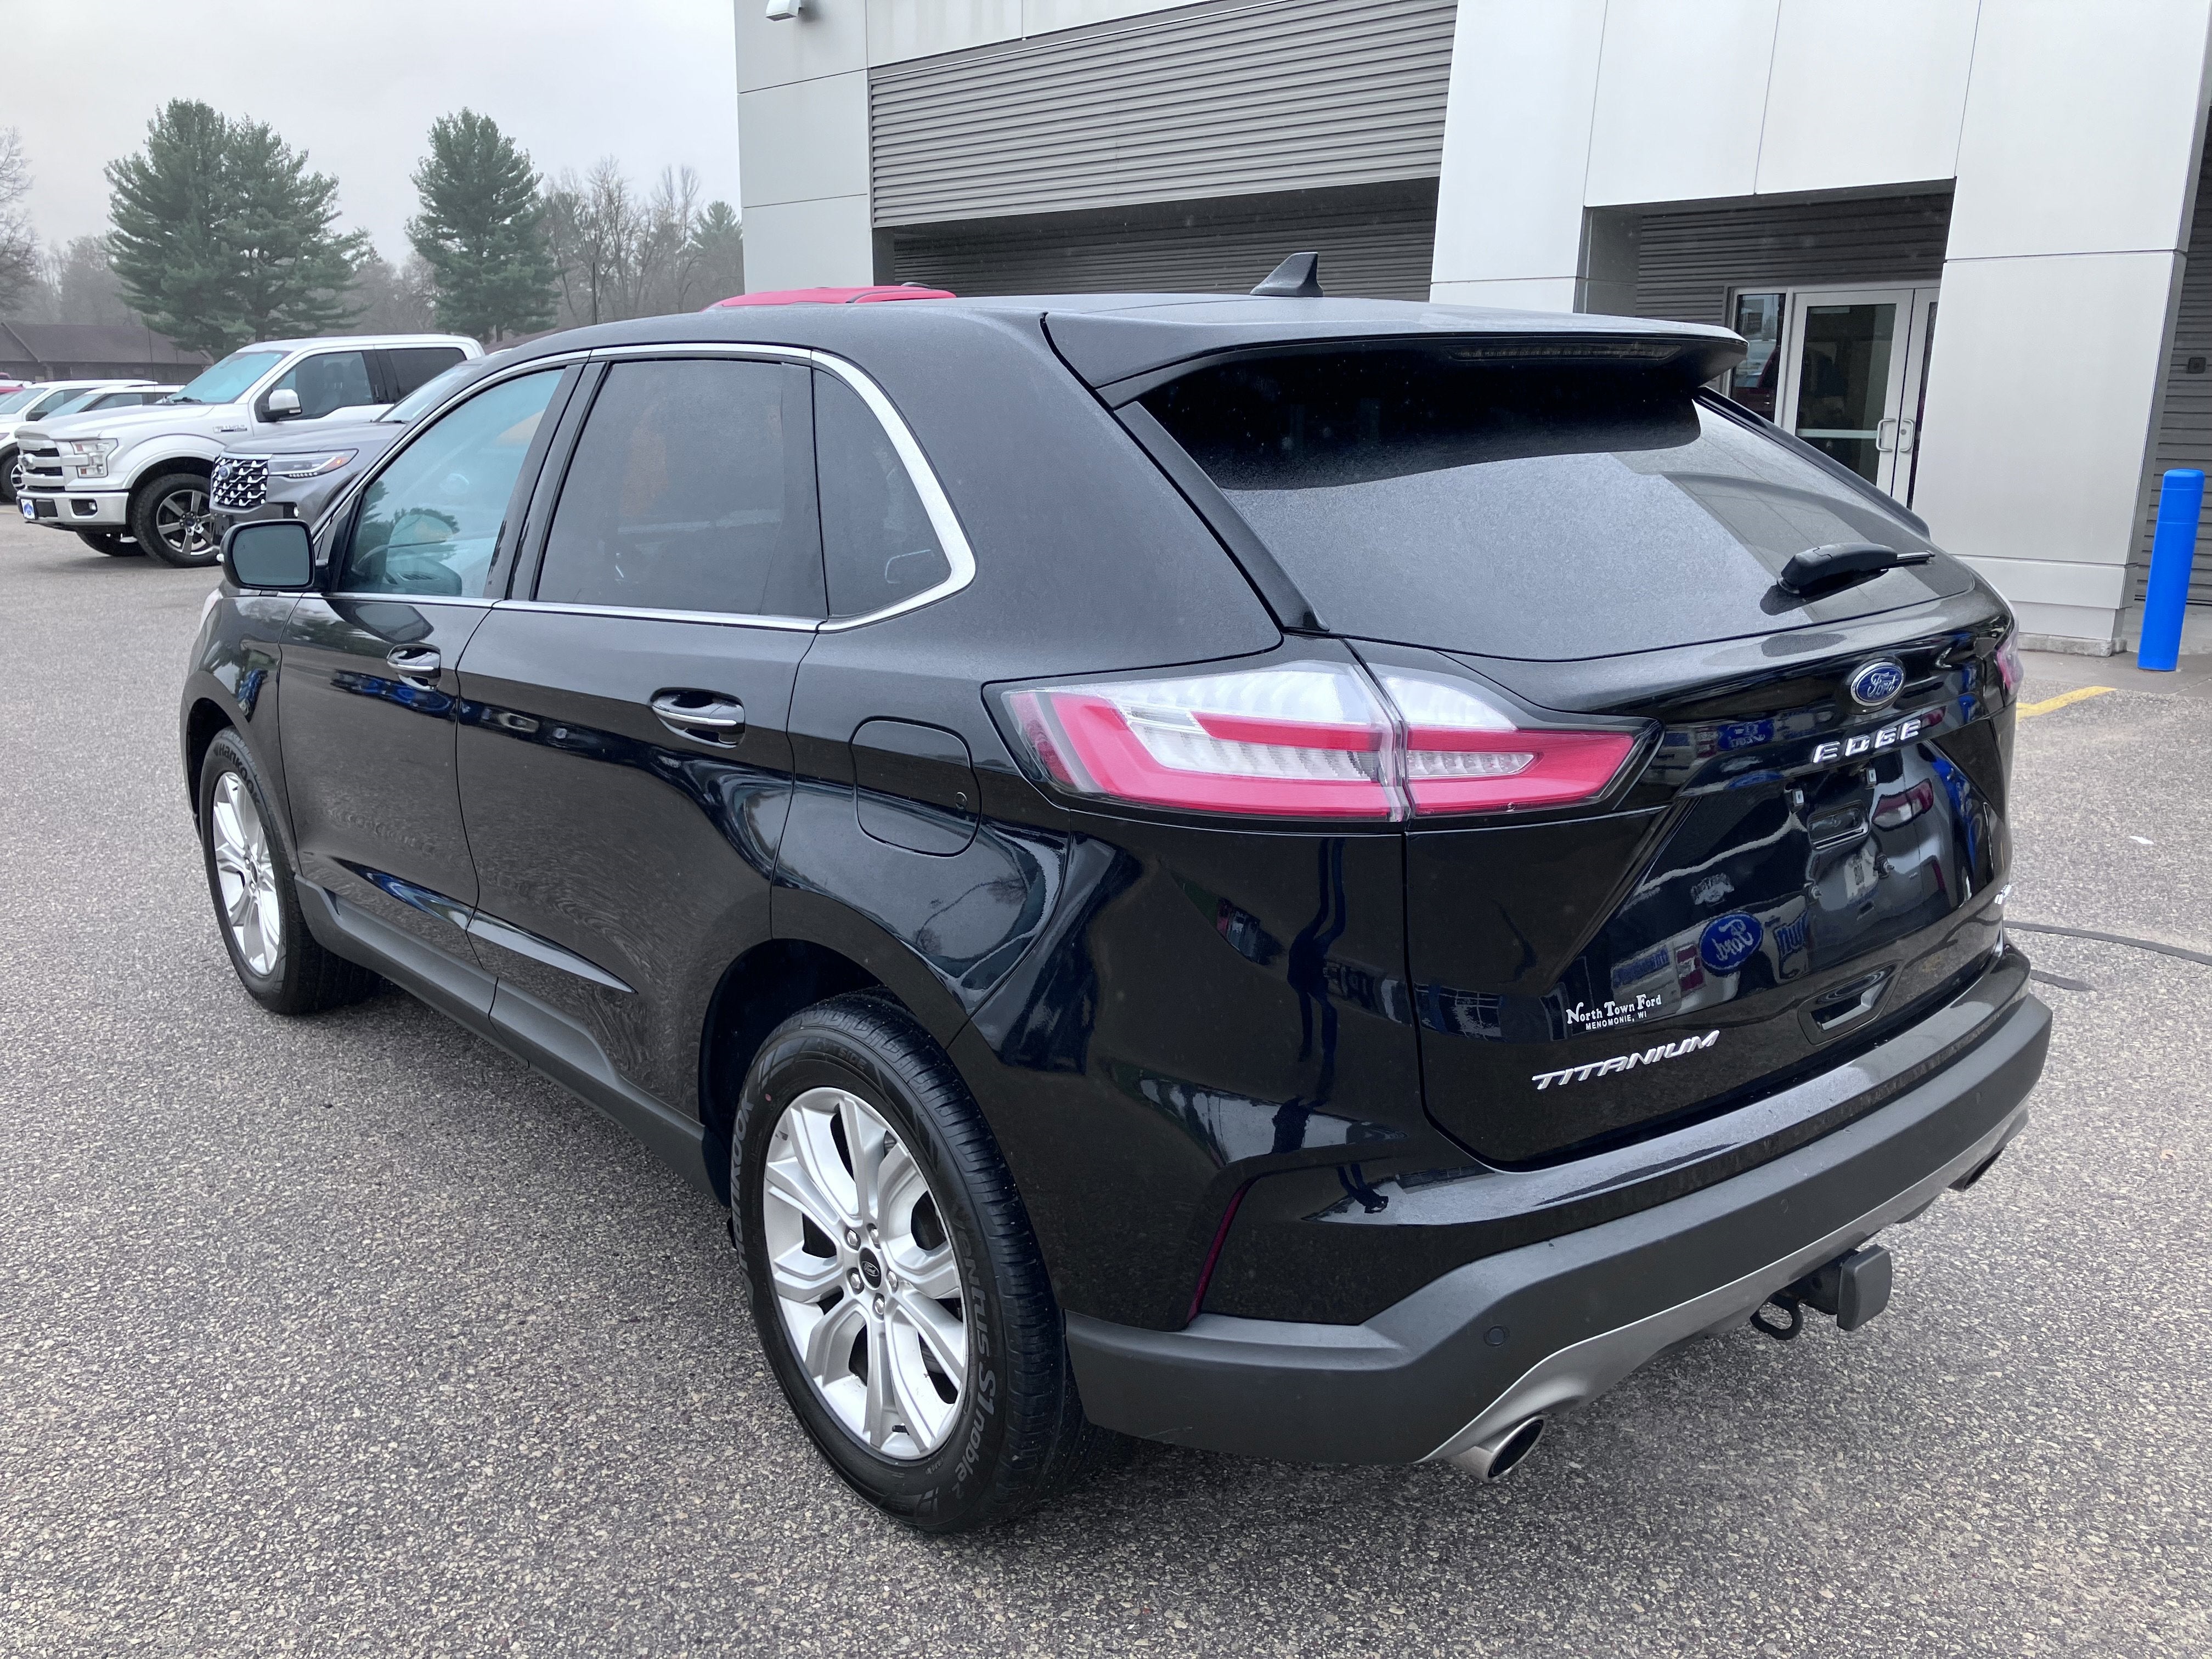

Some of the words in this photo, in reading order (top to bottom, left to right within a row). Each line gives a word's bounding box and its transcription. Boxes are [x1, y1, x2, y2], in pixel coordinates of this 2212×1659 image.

[1867, 672, 1899, 698] Ford
[1813, 719, 1921, 763] EDGE
[1566, 1002, 1603, 1024] North
[1604, 1001, 1635, 1017] Town
[1636, 994, 1662, 1010] Ford
[1585, 1014, 1635, 1030] MENOMONIE,
[1637, 1011, 1647, 1019] WI
[1532, 1030, 1720, 1090] TITANIUM
